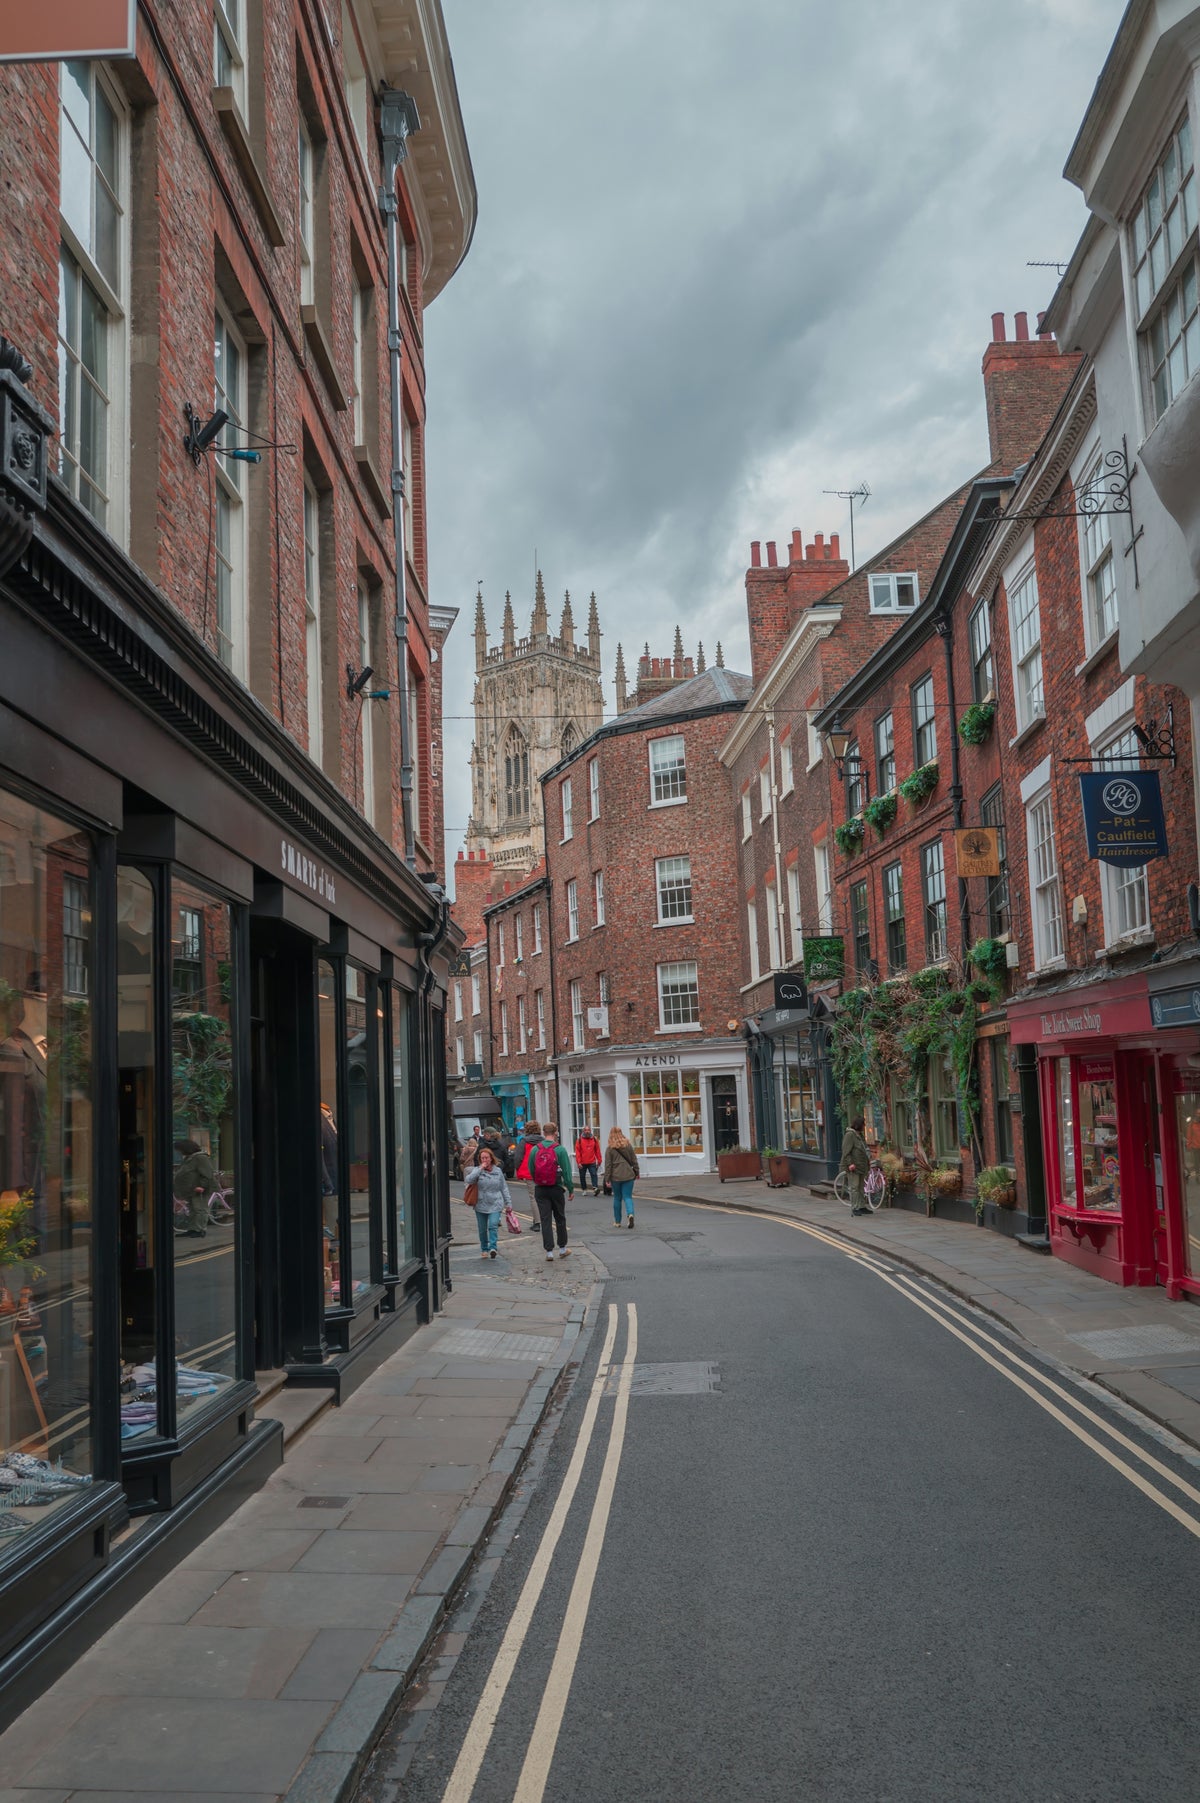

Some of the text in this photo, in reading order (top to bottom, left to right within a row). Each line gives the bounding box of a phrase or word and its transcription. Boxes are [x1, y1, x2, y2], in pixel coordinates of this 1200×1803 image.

[1114, 817, 1136, 827] Pat
[1097, 829, 1156, 841] Caulfield
[281, 840, 317, 890] SMARTS
[319, 868, 324, 896] of
[1041, 1007, 1101, 1035] The York Sweet Shop
[635, 1055, 681, 1067] AZENDI
